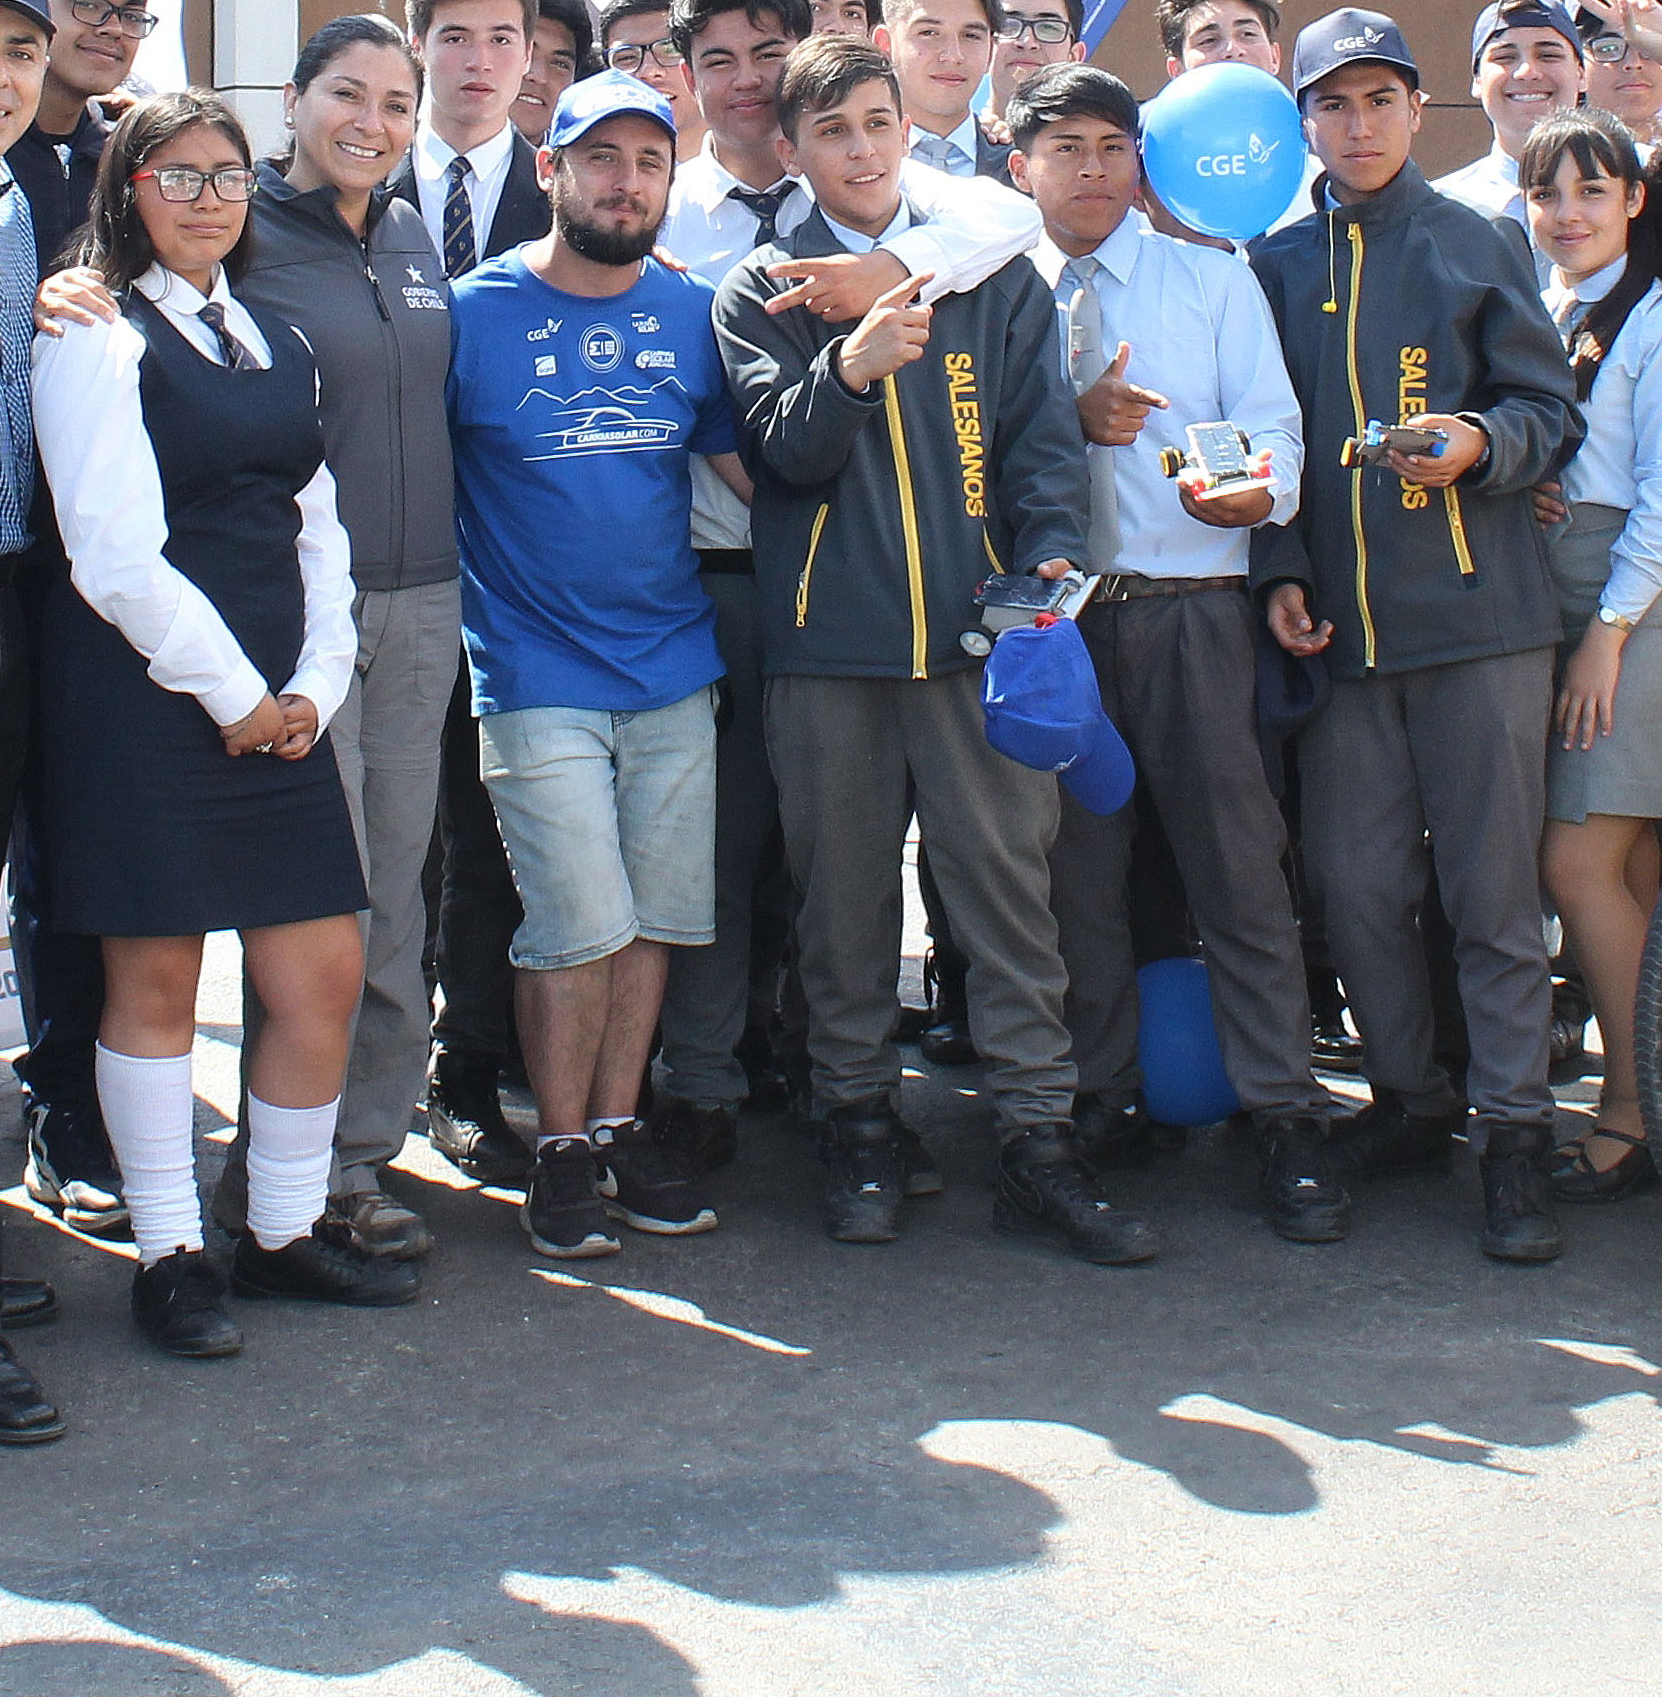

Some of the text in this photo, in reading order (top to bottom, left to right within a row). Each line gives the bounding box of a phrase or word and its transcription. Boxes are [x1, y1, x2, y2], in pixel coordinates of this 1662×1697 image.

[1333, 37, 1366, 52] CGE
[1196, 154, 1247, 177] CGE
[527, 328, 551, 342] CGE
[944, 352, 984, 518] SALESIANOS
